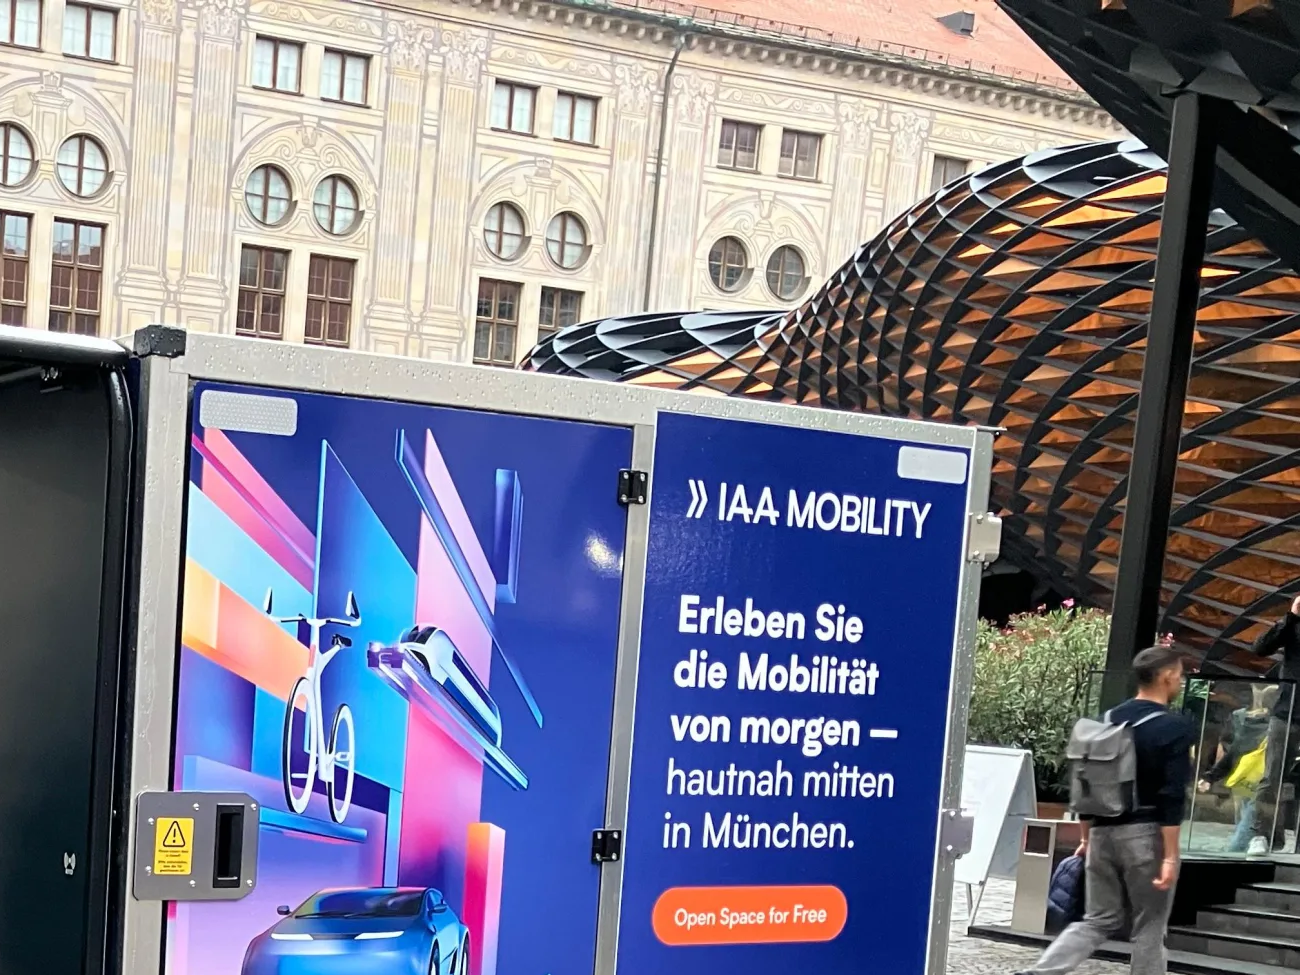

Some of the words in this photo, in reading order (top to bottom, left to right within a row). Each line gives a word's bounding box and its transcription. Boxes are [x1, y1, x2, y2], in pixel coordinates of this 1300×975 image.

[718, 482, 780, 526] IAA
[786, 488, 932, 539] MOBILITY
[678, 594, 806, 640] Erleben
[814, 603, 864, 643] Sie
[673, 648, 728, 690] die
[737, 651, 880, 696] Mobilität
[670, 714, 731, 743] von
[739, 716, 861, 757] morgen
[666, 757, 793, 797] hautnah
[802, 761, 895, 798] mitten
[662, 812, 691, 849] in
[702, 811, 855, 849] München.
[673, 907, 716, 930] Open
[719, 907, 766, 929] Space
[768, 906, 790, 924] for
[792, 903, 828, 924] Free
